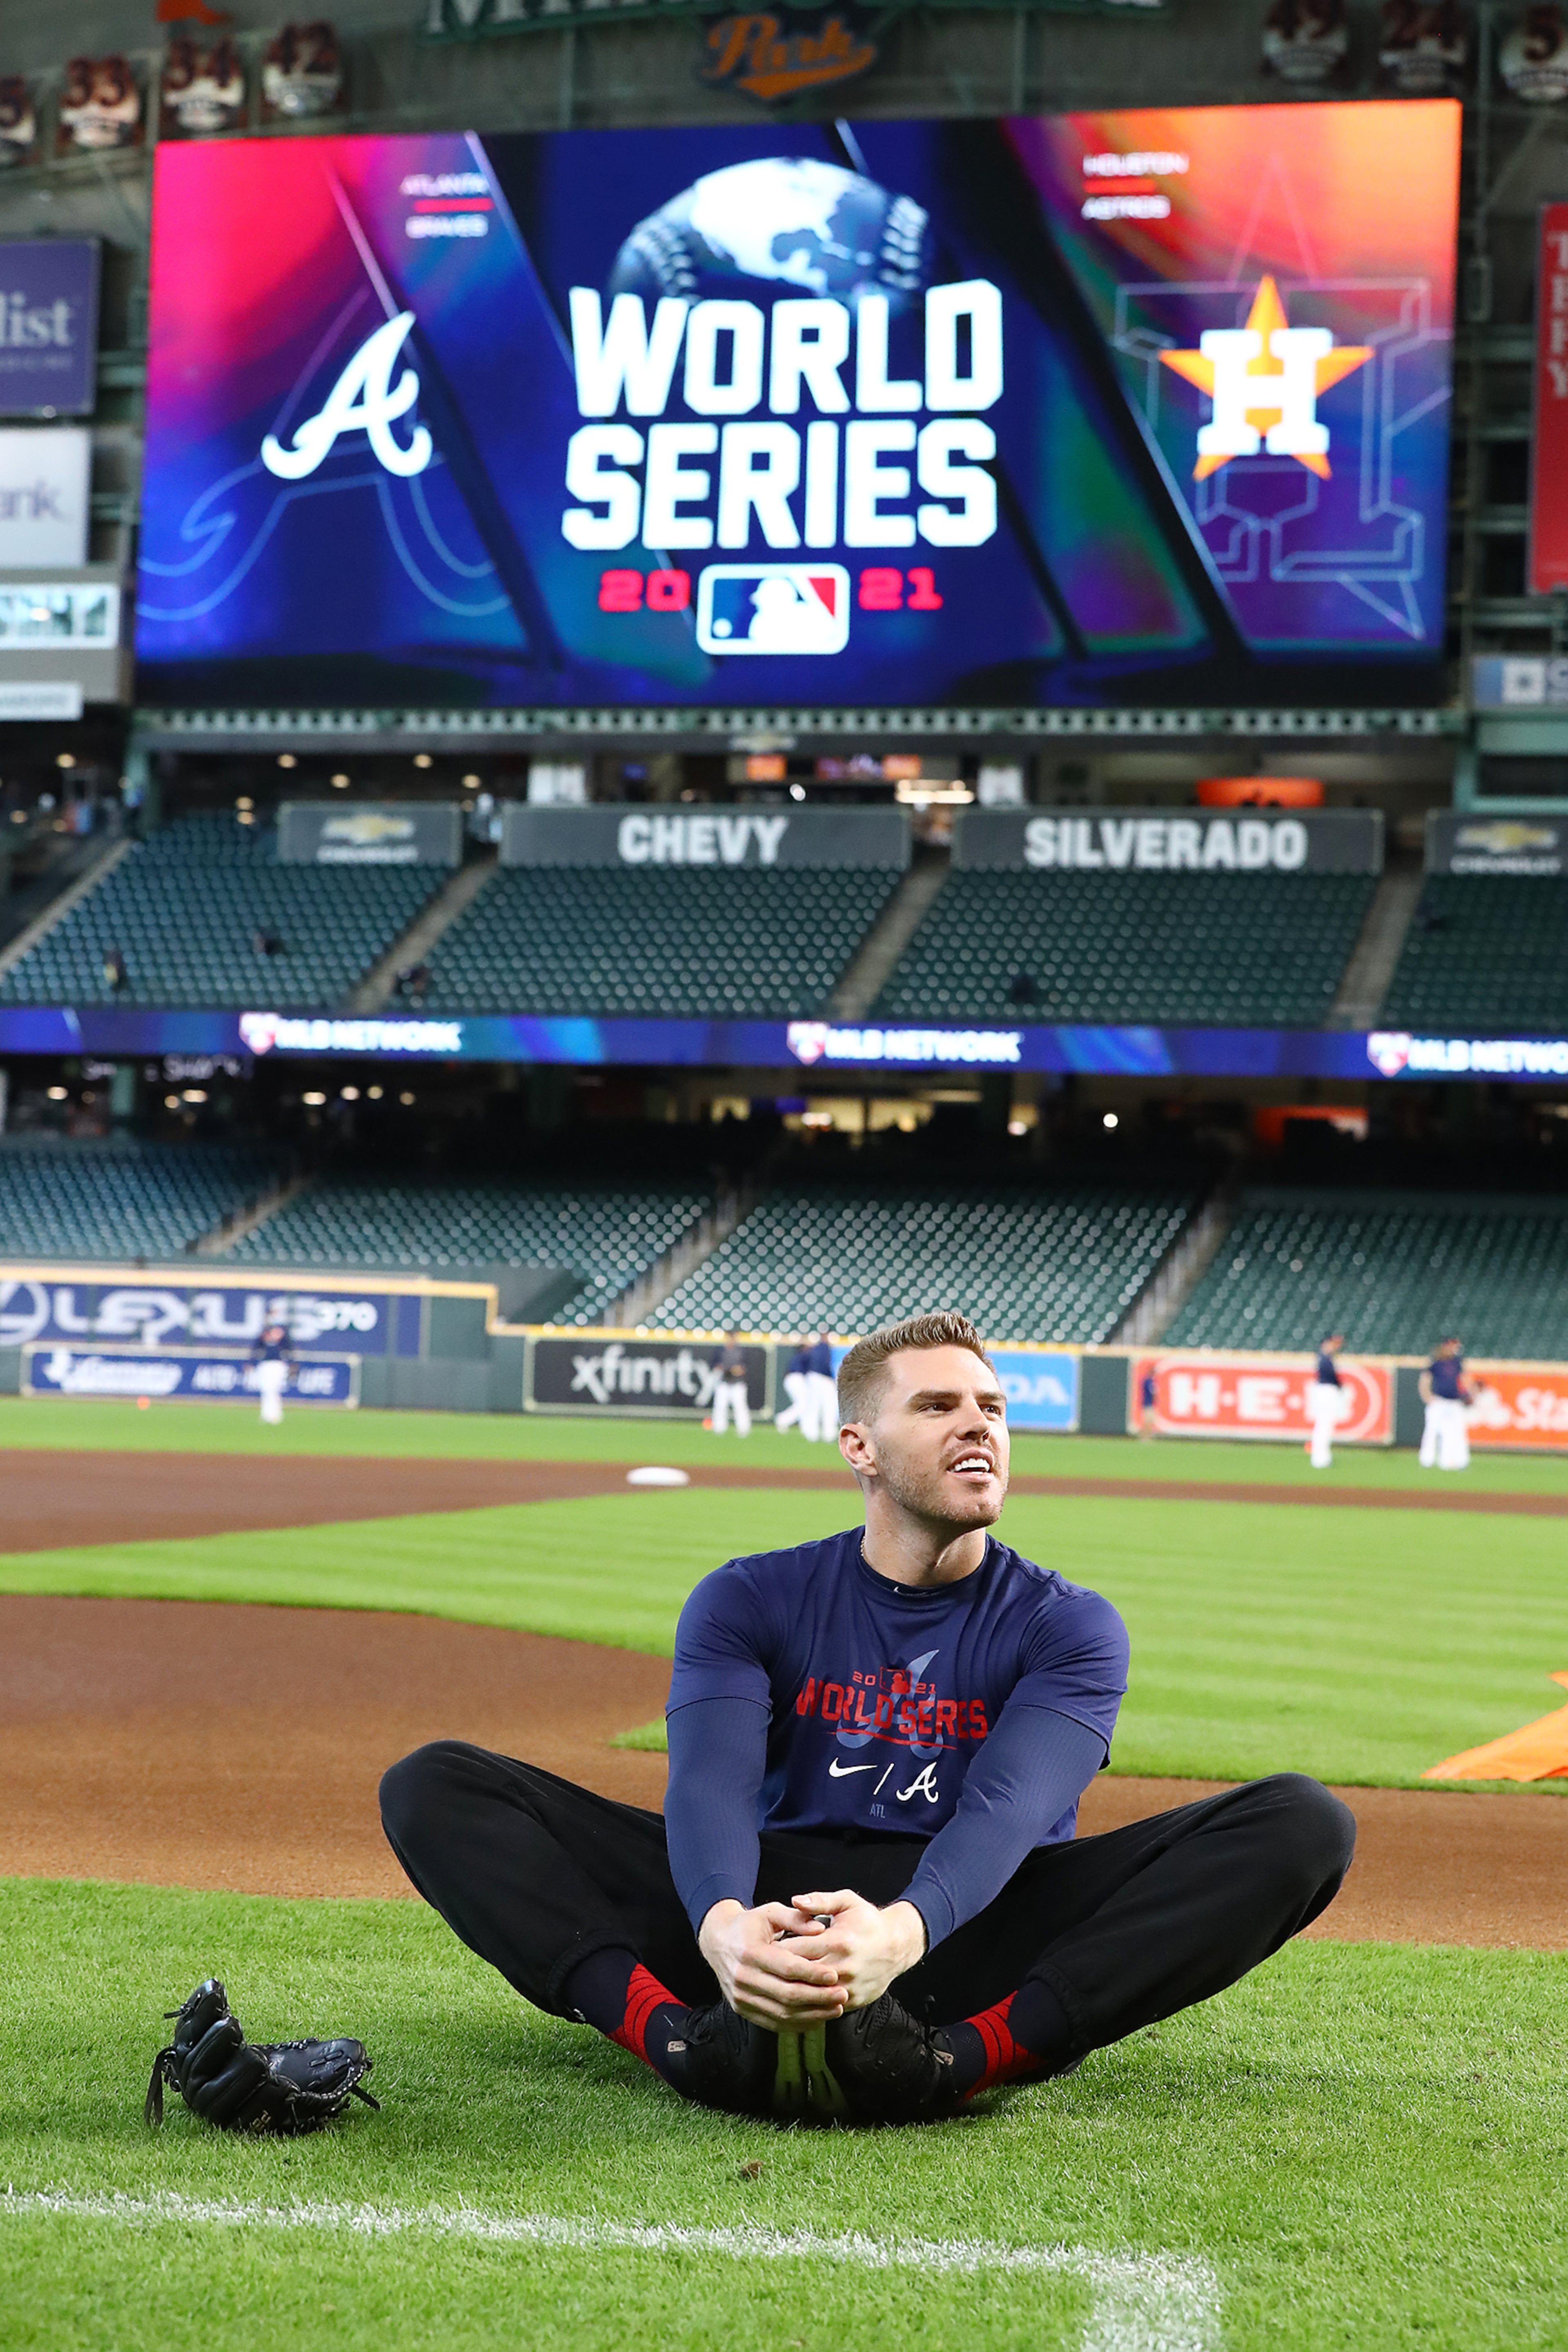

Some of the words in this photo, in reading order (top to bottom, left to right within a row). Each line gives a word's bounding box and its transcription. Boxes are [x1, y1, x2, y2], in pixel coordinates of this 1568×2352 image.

[569, 279, 1004, 417] WORLD
[261, 310, 432, 479] A
[1197, 327, 1333, 456] H
[561, 419, 998, 550] SERIES
[598, 569, 691, 612] 20
[859, 567, 943, 610] 21
[617, 815, 788, 864] CHEVY
[1024, 818, 1308, 870] SILVERADO
[331, 1020, 464, 1052] NETWORK
[884, 1029, 1024, 1062] NETWORK
[53, 1287, 325, 1350] LEXUS
[570, 1344, 722, 1407] xfinity
[796, 1676, 894, 1729] WORLD
[899, 1699, 988, 1739] SERES
[852, 1670, 876, 1686] 20
[915, 1683, 936, 1694] 21
[896, 1761, 938, 1804] A
[869, 1803, 886, 1818] ATL
